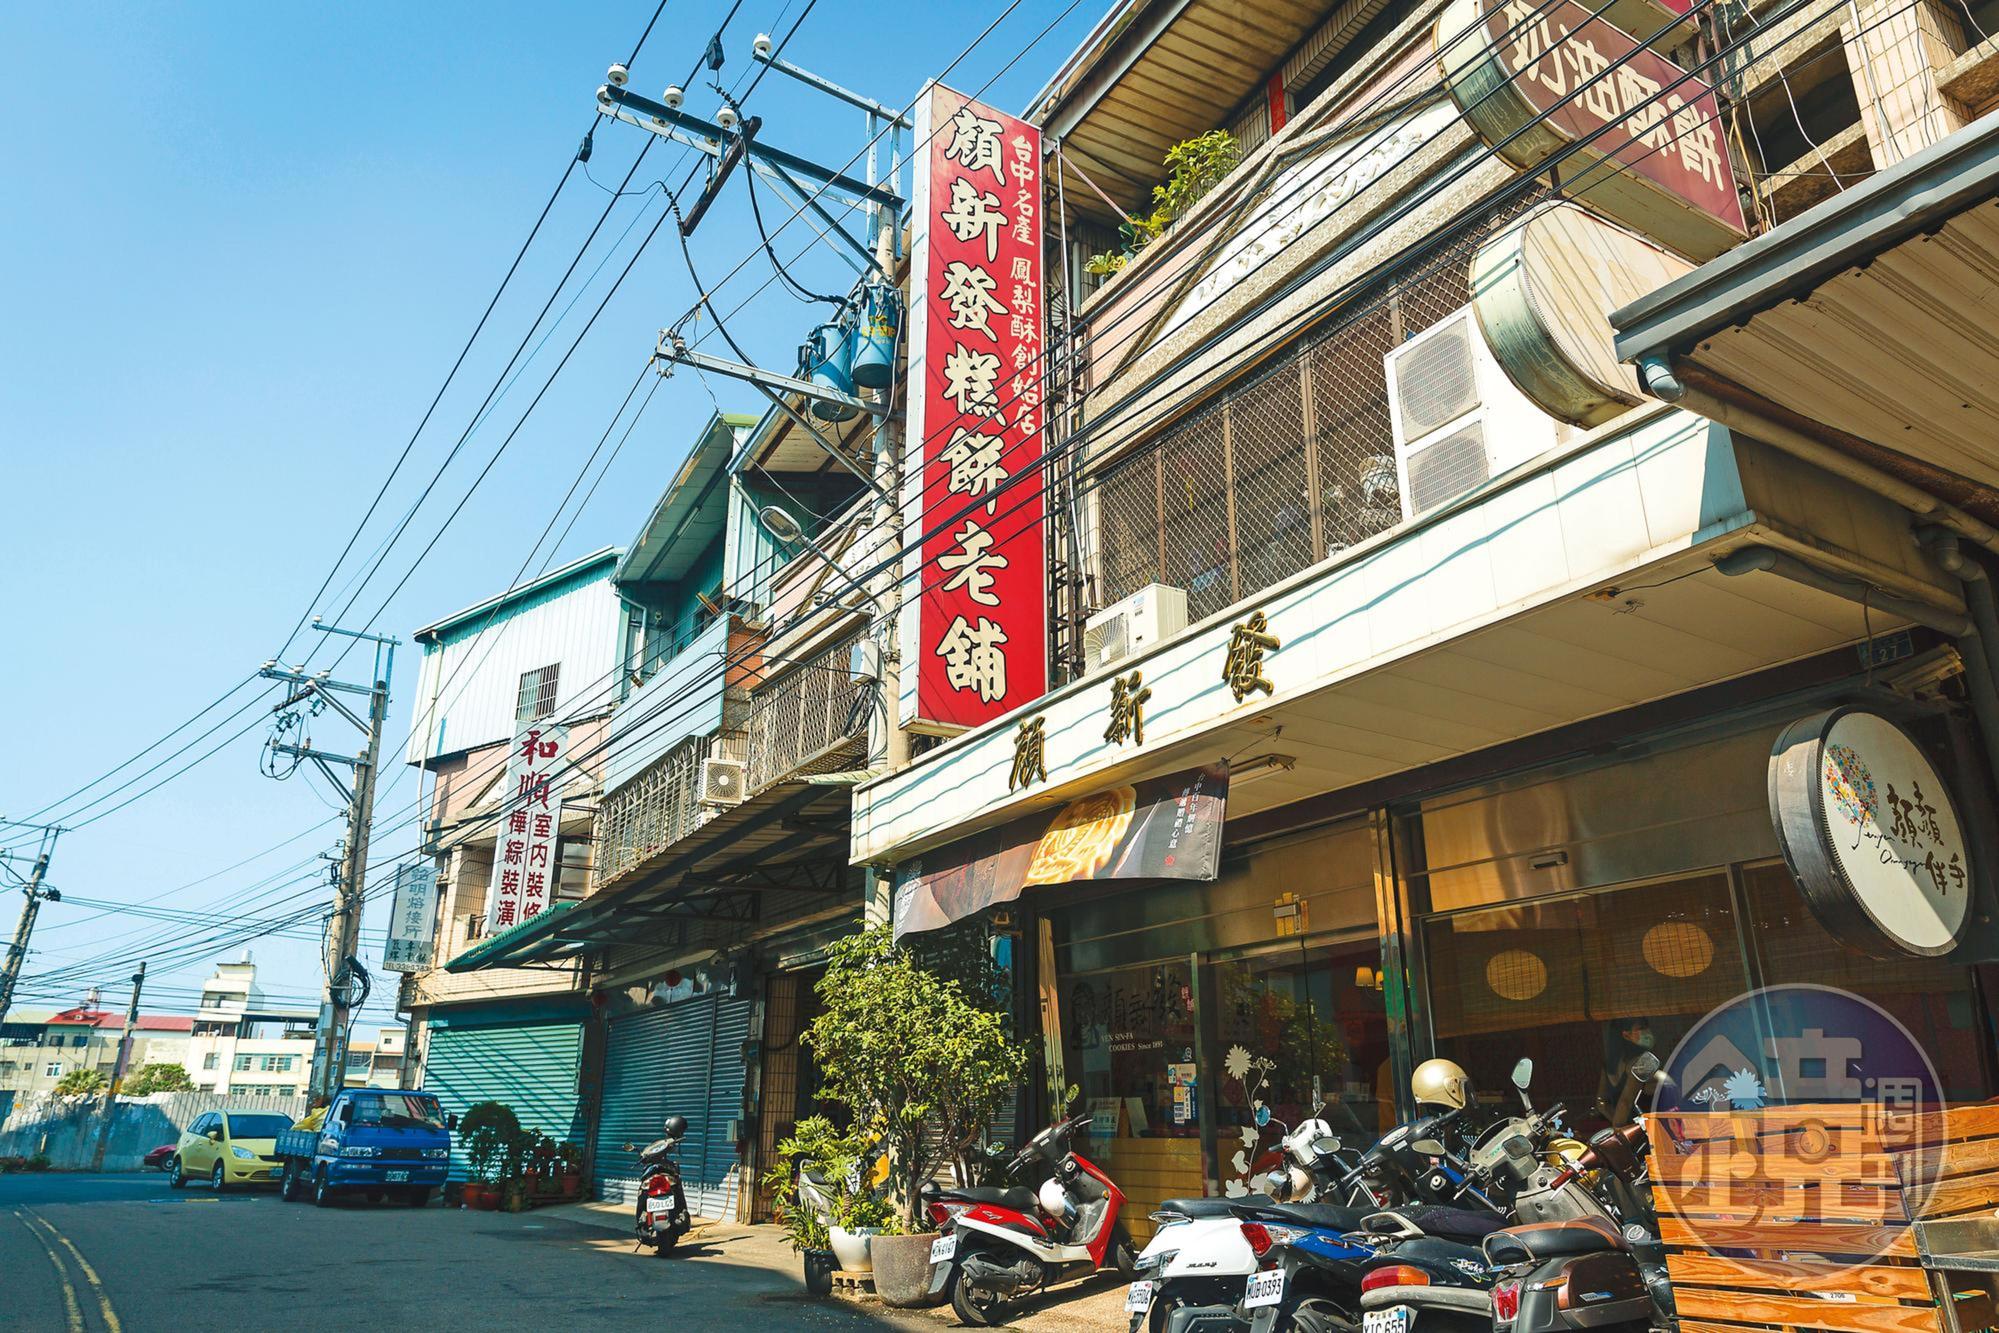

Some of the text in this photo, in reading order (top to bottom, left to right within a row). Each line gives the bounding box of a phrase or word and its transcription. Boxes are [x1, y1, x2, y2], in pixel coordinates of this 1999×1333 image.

[1010, 134, 1040, 437] 台中名產 鳳梨酥創始店
